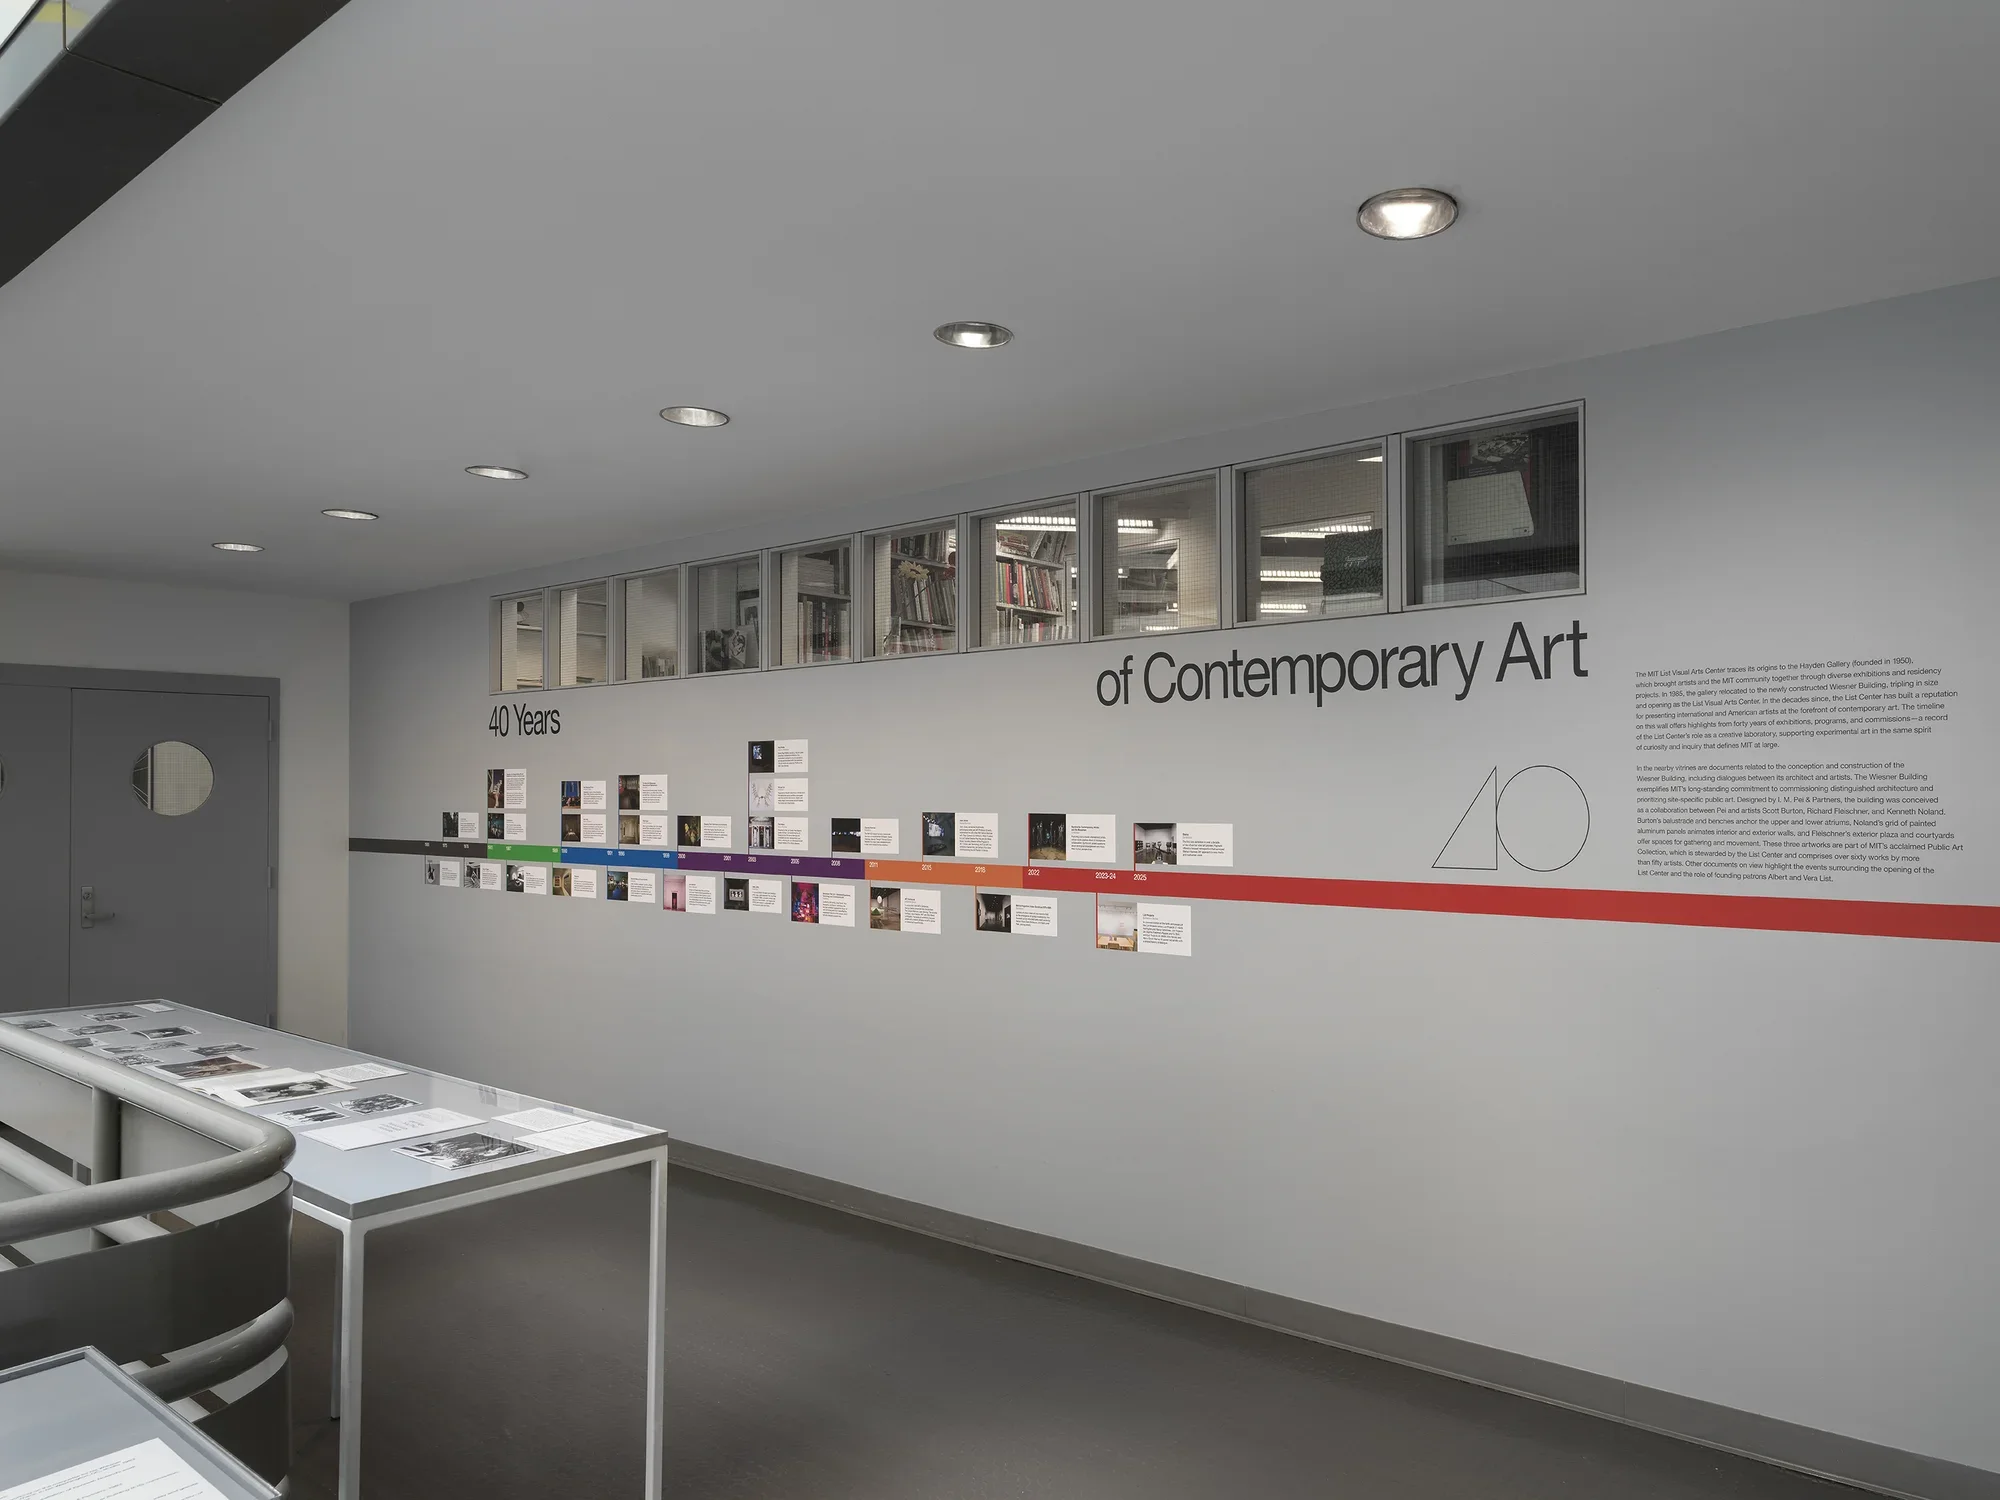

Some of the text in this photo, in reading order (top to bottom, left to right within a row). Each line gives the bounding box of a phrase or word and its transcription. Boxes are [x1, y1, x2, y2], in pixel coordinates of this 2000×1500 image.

[1096, 620, 1588, 707] of Contemporary Art
[1757, 663, 1778, 673] origins
[1800, 660, 1825, 671] Hayden
[1826, 659, 1850, 669] Gallery
[1852, 658, 1882, 668] (founded
[1736, 674, 1770, 685] community
[1772, 673, 1798, 683] together
[1801, 672, 1826, 682] through
[1827, 670, 1852, 679] diverse
[1853, 669, 1890, 678] exhibitions
[1908, 666, 1941, 677] residency
[1769, 685, 1787, 694] newly
[1789, 683, 1828, 692] constructed
[1829, 682, 1857, 690] Wiesner
[1890, 679, 1914, 689] tripling
[1859, 692, 1882, 700] Center
[1922, 689, 1958, 699] reputation
[1800, 706, 1828, 714] forefront
[1838, 703, 1886, 714] contemporary
[1917, 701, 1944, 710] timeline
[489, 703, 561, 737] 40 Years
[1779, 728, 1814, 738] supporting
[1816, 727, 1858, 737] experimental
[1914, 725, 1931, 735] spirit
[1682, 742, 1702, 751] inquiry
[1788, 762, 1824, 771] conception
[1899, 772, 1927, 781] Building
[1688, 784, 1729, 793] long-standing
[1780, 784, 1828, 793] commissioning
[1830, 784, 1875, 793] distinguished
[1857, 796, 1884, 804] building
[1885, 819, 1898, 828] grid
[1910, 819, 1936, 828] painted
[1880, 830, 1898, 839] plaza
[1916, 831, 1954, 840] courtyards
[1845, 841, 1858, 850] part
[1798, 851, 1832, 861] comprises
[1851, 853, 1866, 862] sixty
[1891, 854, 1900, 863] by
[1829, 863, 1869, 873] surrounding
[1884, 865, 1912, 874] opening
[1714, 871, 1741, 880] founding
[1743, 872, 1766, 881] patrons
